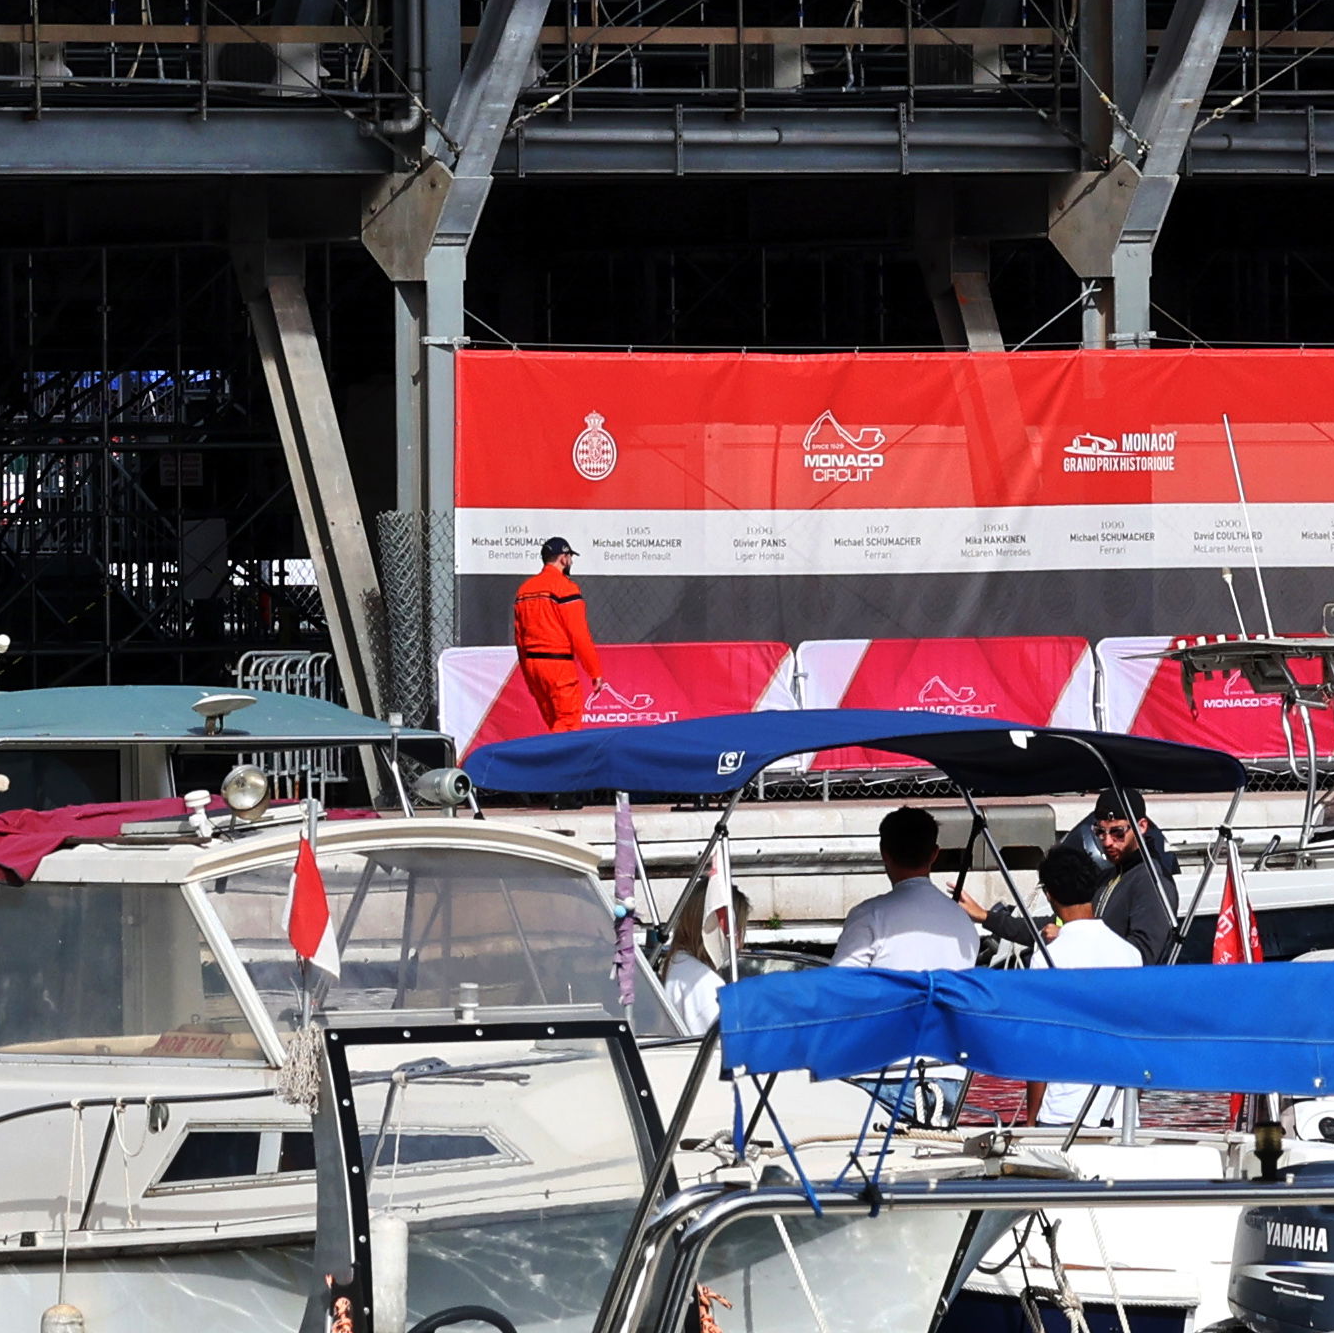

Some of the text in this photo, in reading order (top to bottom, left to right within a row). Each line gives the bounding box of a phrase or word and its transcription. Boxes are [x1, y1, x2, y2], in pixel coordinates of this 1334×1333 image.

[1122, 433, 1175, 451] MONACO
[804, 454, 884, 467] MONACO
[813, 468, 873, 482] CIRCUIT
[965, 536, 982, 545] Mika
[1070, 532, 1155, 542] Michael SCHUMACHER
[1194, 531, 1215, 541] David
[1301, 531, 1330, 540] Michael
[472, 537, 548, 547] Michael SCHUMAC
[592, 538, 682, 548] Michael SCHUMACHER
[733, 539, 786, 548] Olivier PANIS
[834, 537, 921, 547] Michael SCHUMACHER
[864, 550, 891, 559] Ferrari
[1099, 545, 1126, 554] Ferrari
[488, 550, 542, 560] Benetton For
[1204, 699, 1260, 708] MONACO
[1267, 1222, 1328, 1253] YAMAHA
